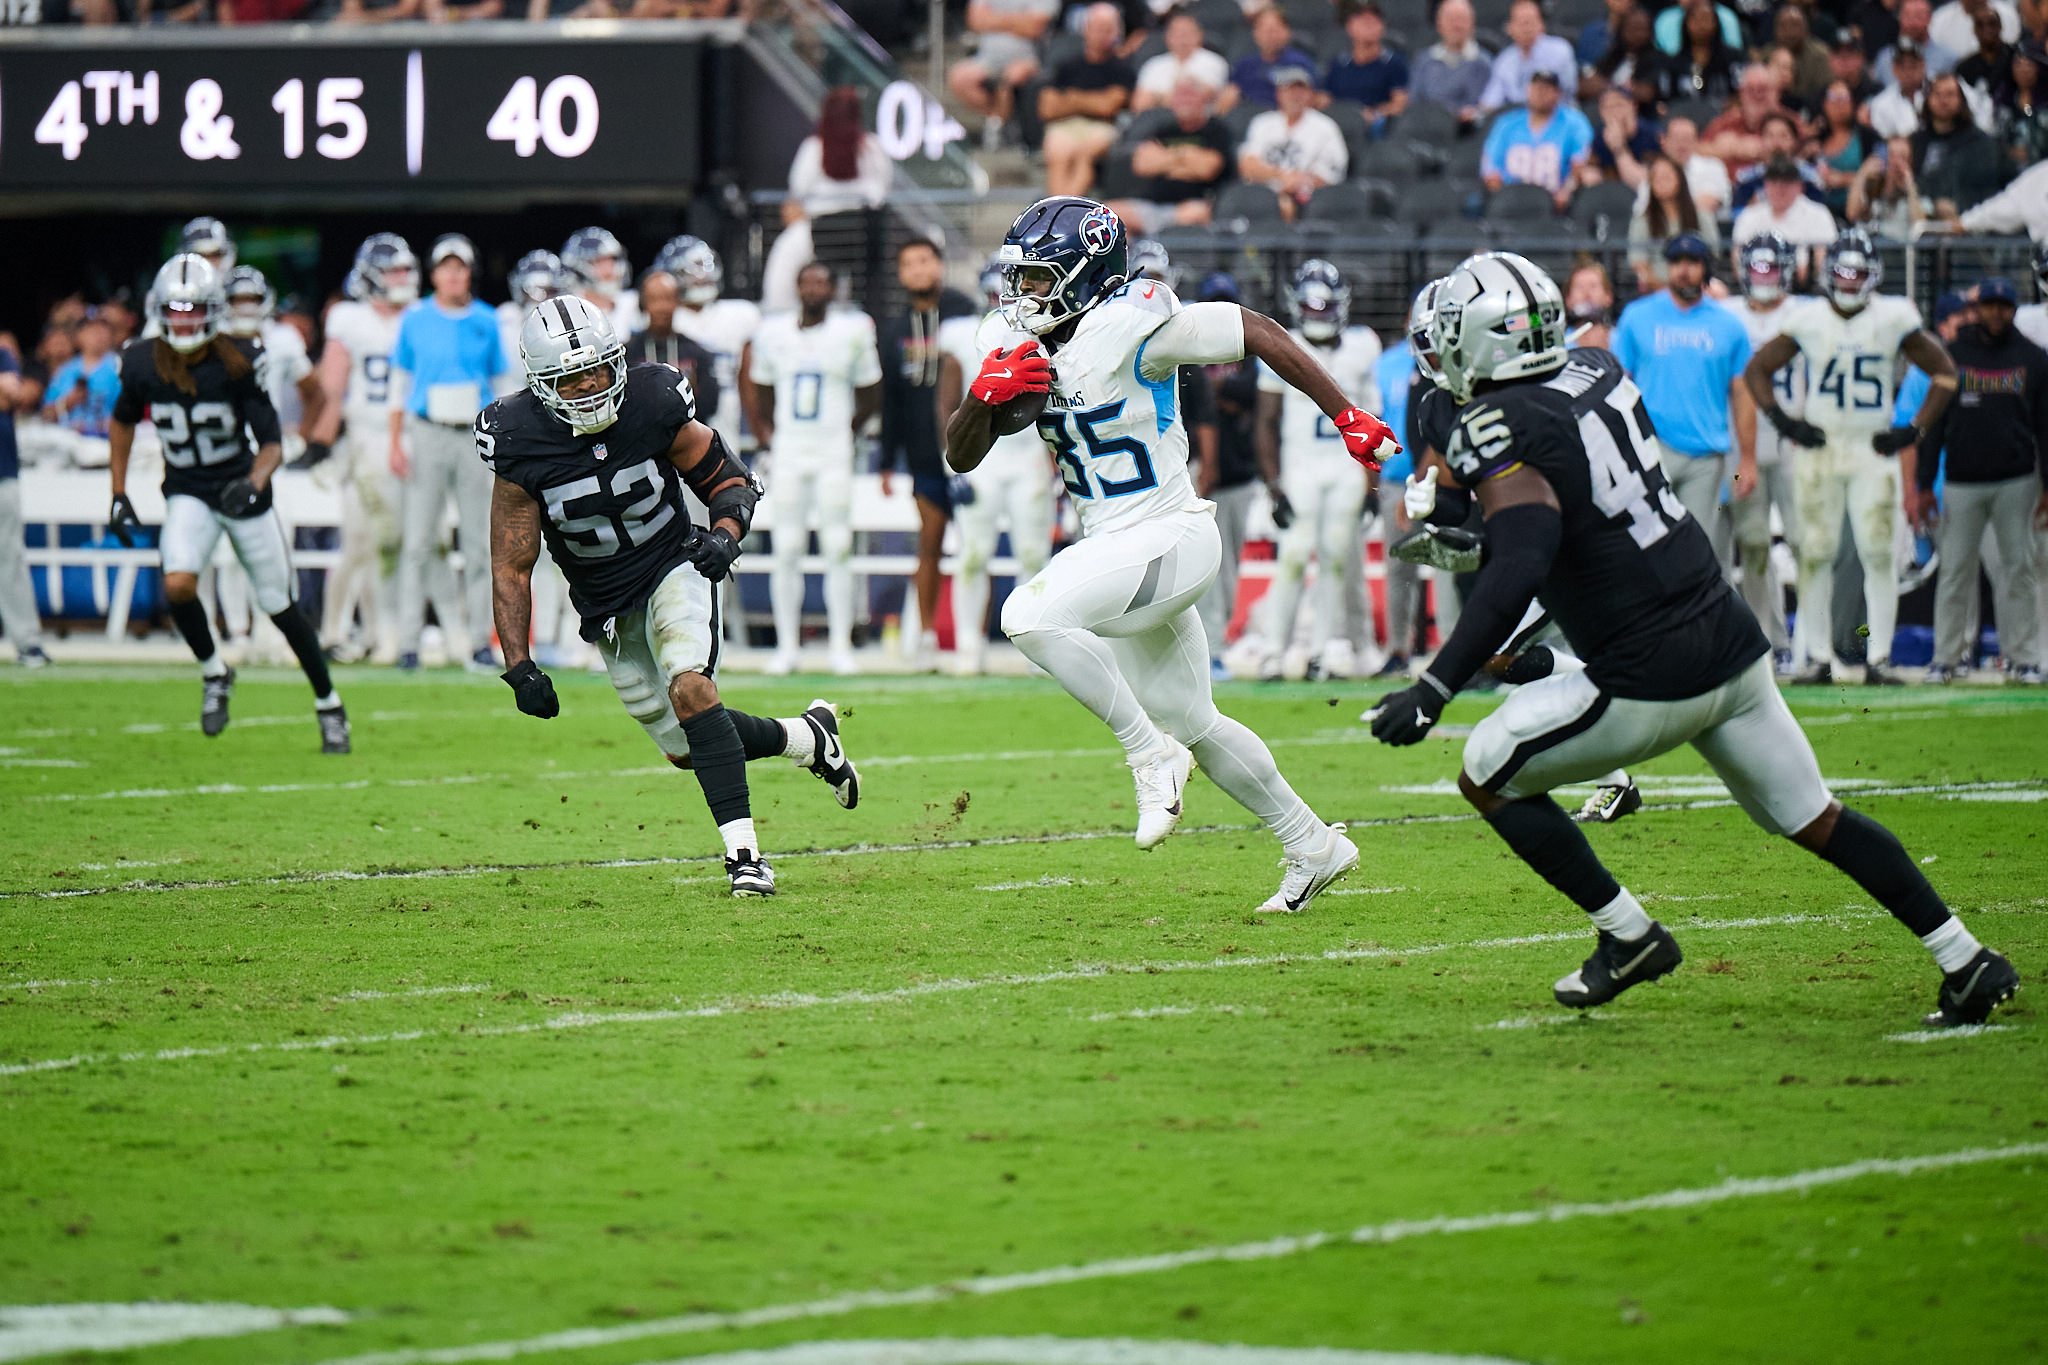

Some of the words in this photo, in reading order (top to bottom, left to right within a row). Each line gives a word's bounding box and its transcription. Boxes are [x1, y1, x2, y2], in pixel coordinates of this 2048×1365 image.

[34, 70, 160, 161] 4TH
[180, 78, 242, 160] &
[271, 77, 368, 160] 15
[486, 74, 600, 158] 40
[1517, 330, 1556, 354] 45
[1818, 355, 1883, 409] 45
[149, 401, 243, 469] 22
[1035, 397, 1159, 500] 85
[1446, 408, 1513, 476] 45
[1576, 375, 1688, 550] 45
[540, 458, 676, 559] 52
